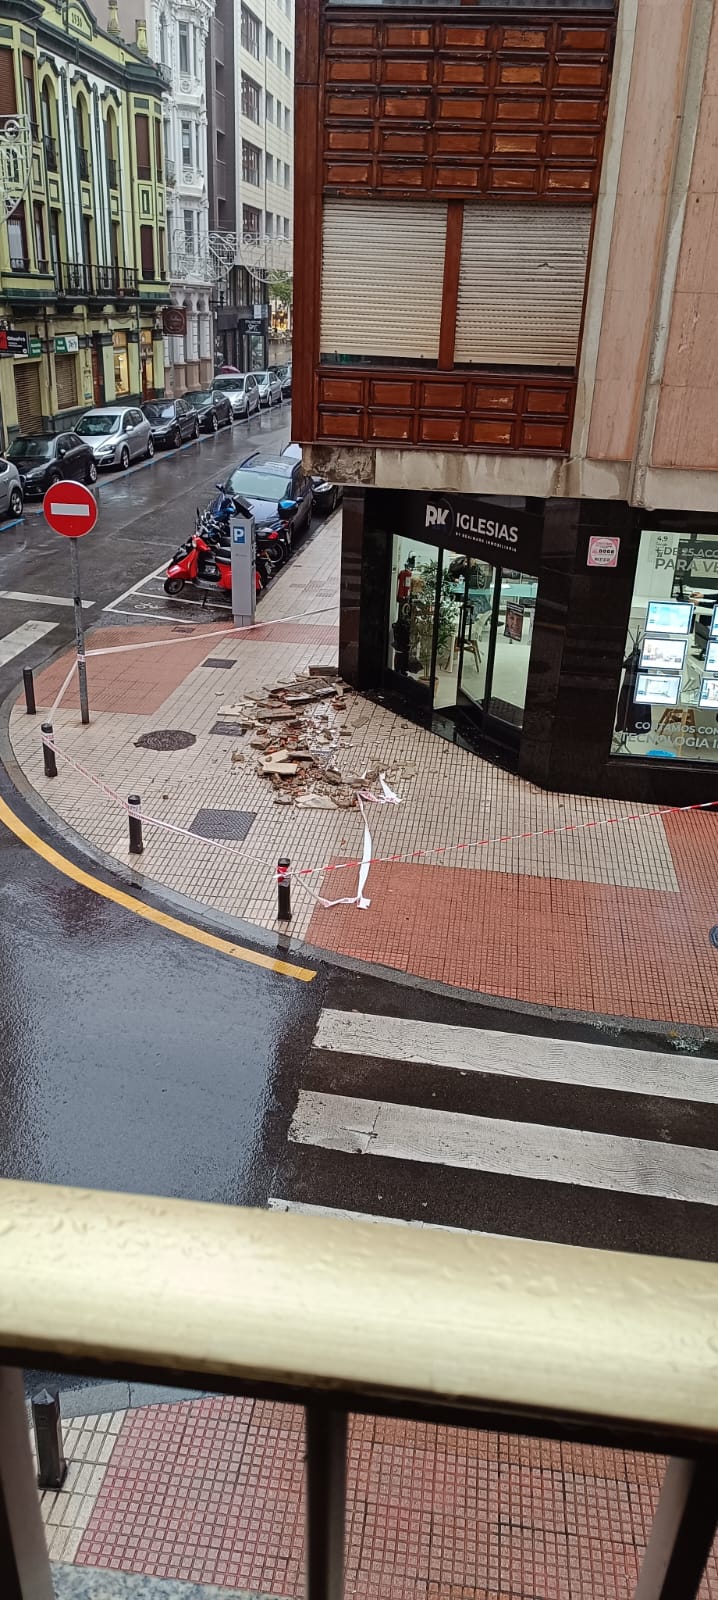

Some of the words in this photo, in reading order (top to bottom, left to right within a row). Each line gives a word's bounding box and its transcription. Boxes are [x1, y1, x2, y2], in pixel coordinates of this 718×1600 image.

[425, 504, 450, 527] RK
[233, 527, 244, 541] P
[455, 512, 519, 543] IGLESIAS
[655, 558, 698, 572] PARA
[634, 721, 696, 733] COTAMOS
